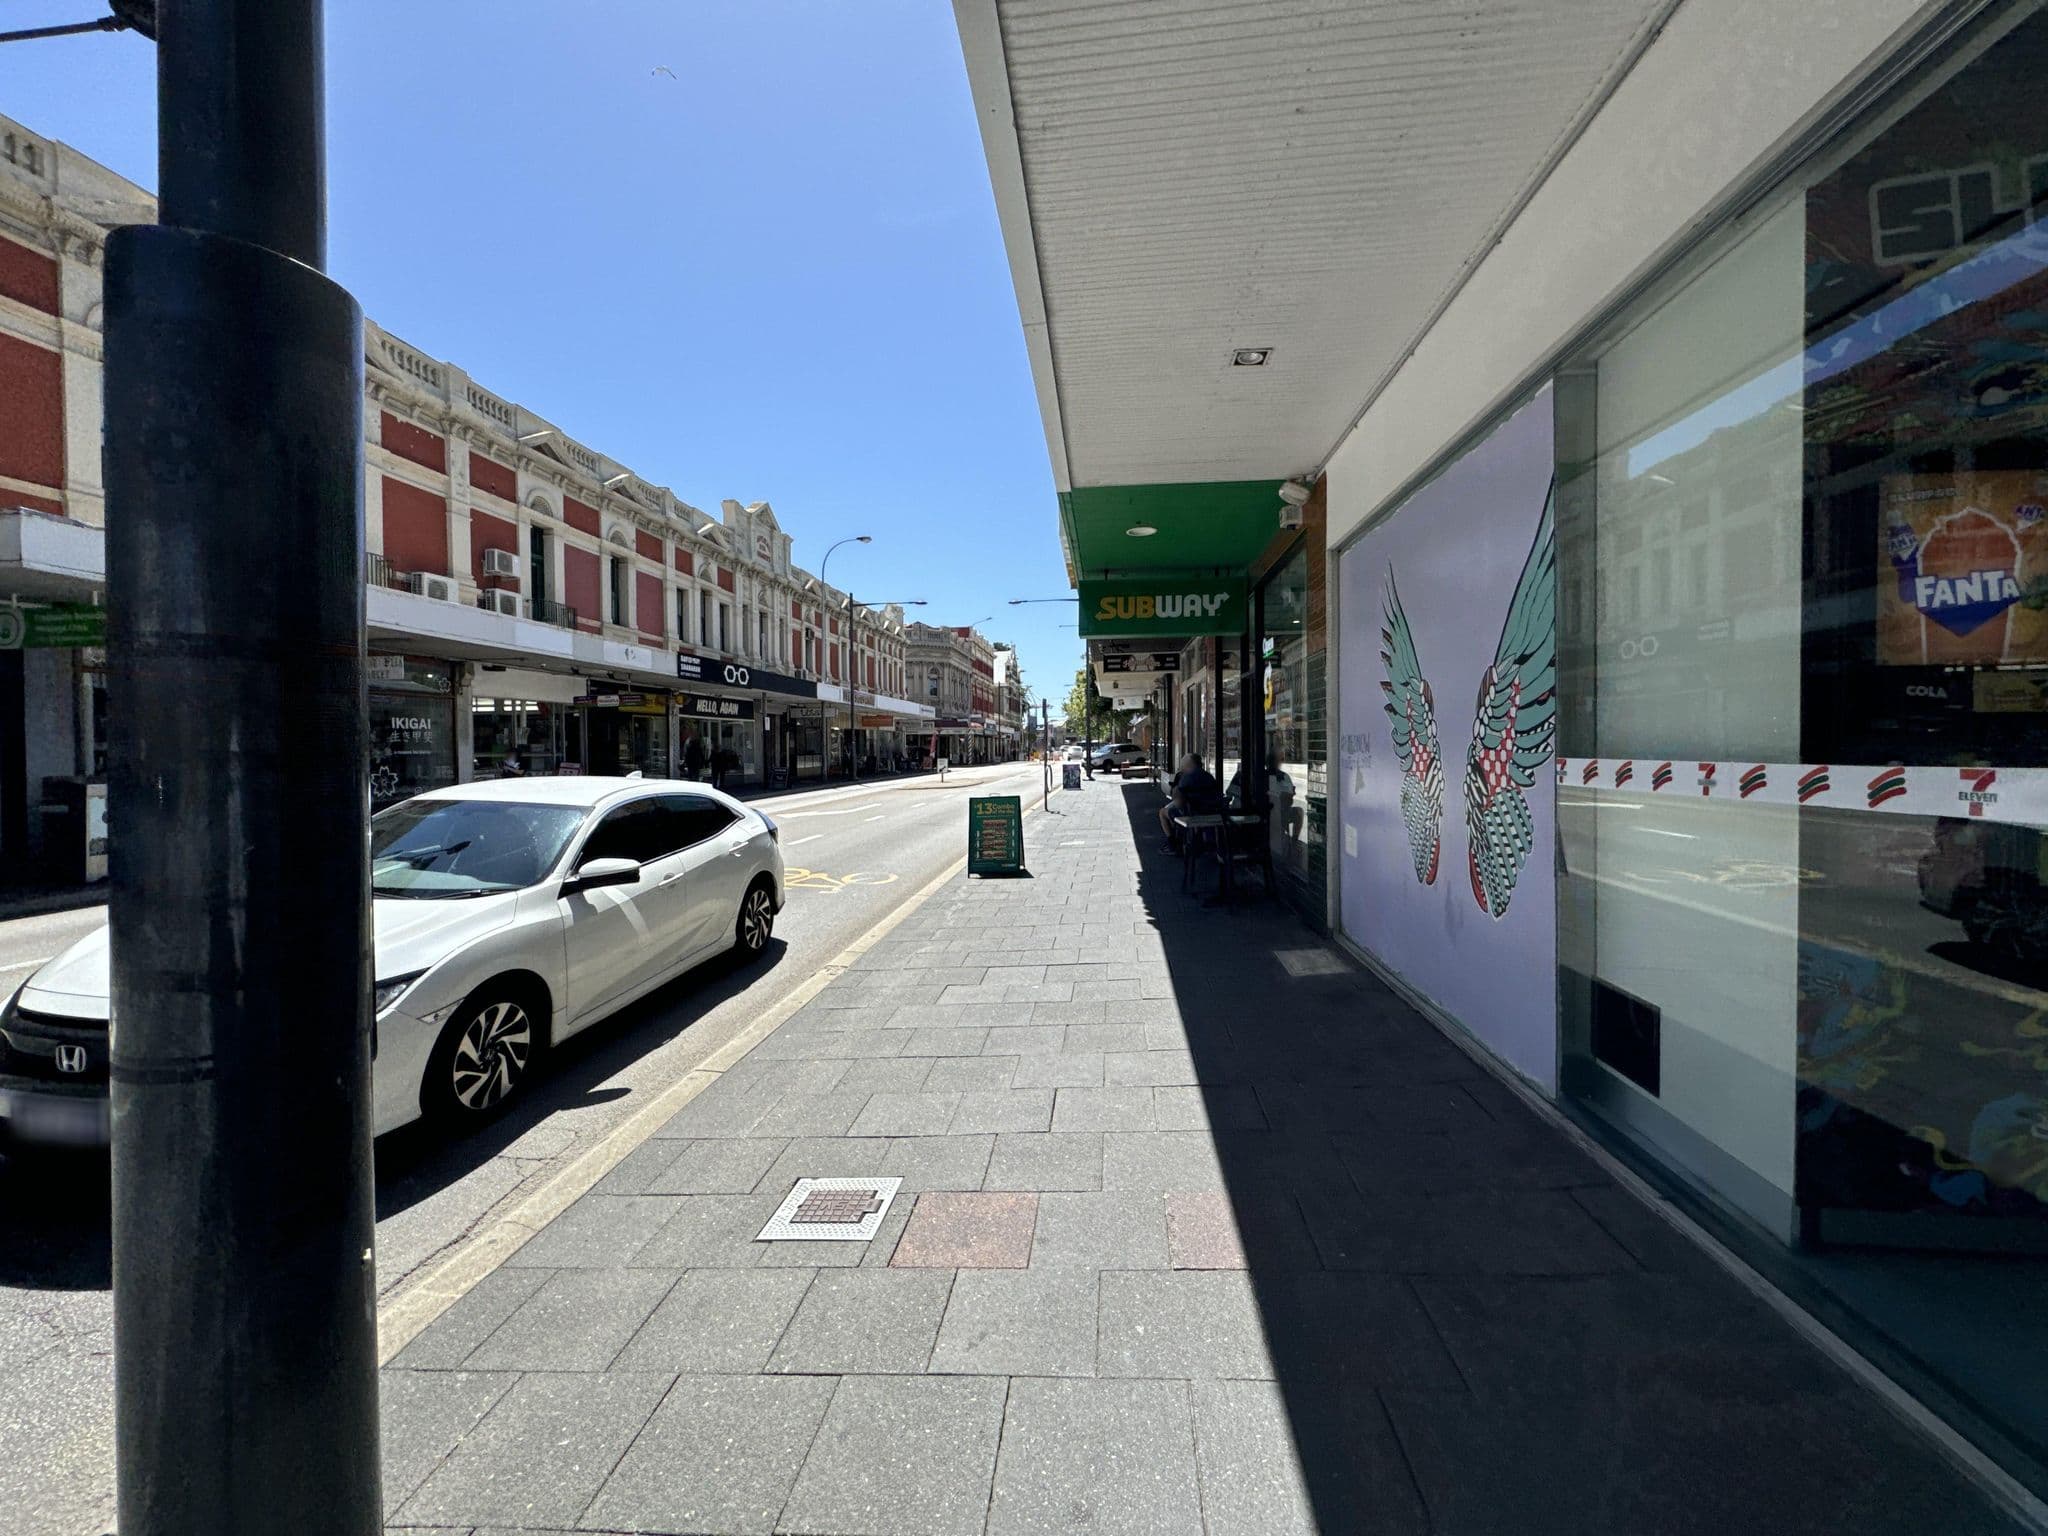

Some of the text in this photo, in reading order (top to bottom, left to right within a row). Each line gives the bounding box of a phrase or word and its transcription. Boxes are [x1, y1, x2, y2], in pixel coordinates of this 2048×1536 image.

[1914, 570, 2021, 609] FANTA
[1095, 591, 1230, 622] SUBWAY
[1905, 685, 1948, 700] COLA
[696, 698, 739, 716] HELLO, AGAIN
[391, 717, 432, 730] IKIGAI
[1959, 768, 1996, 816] 7
